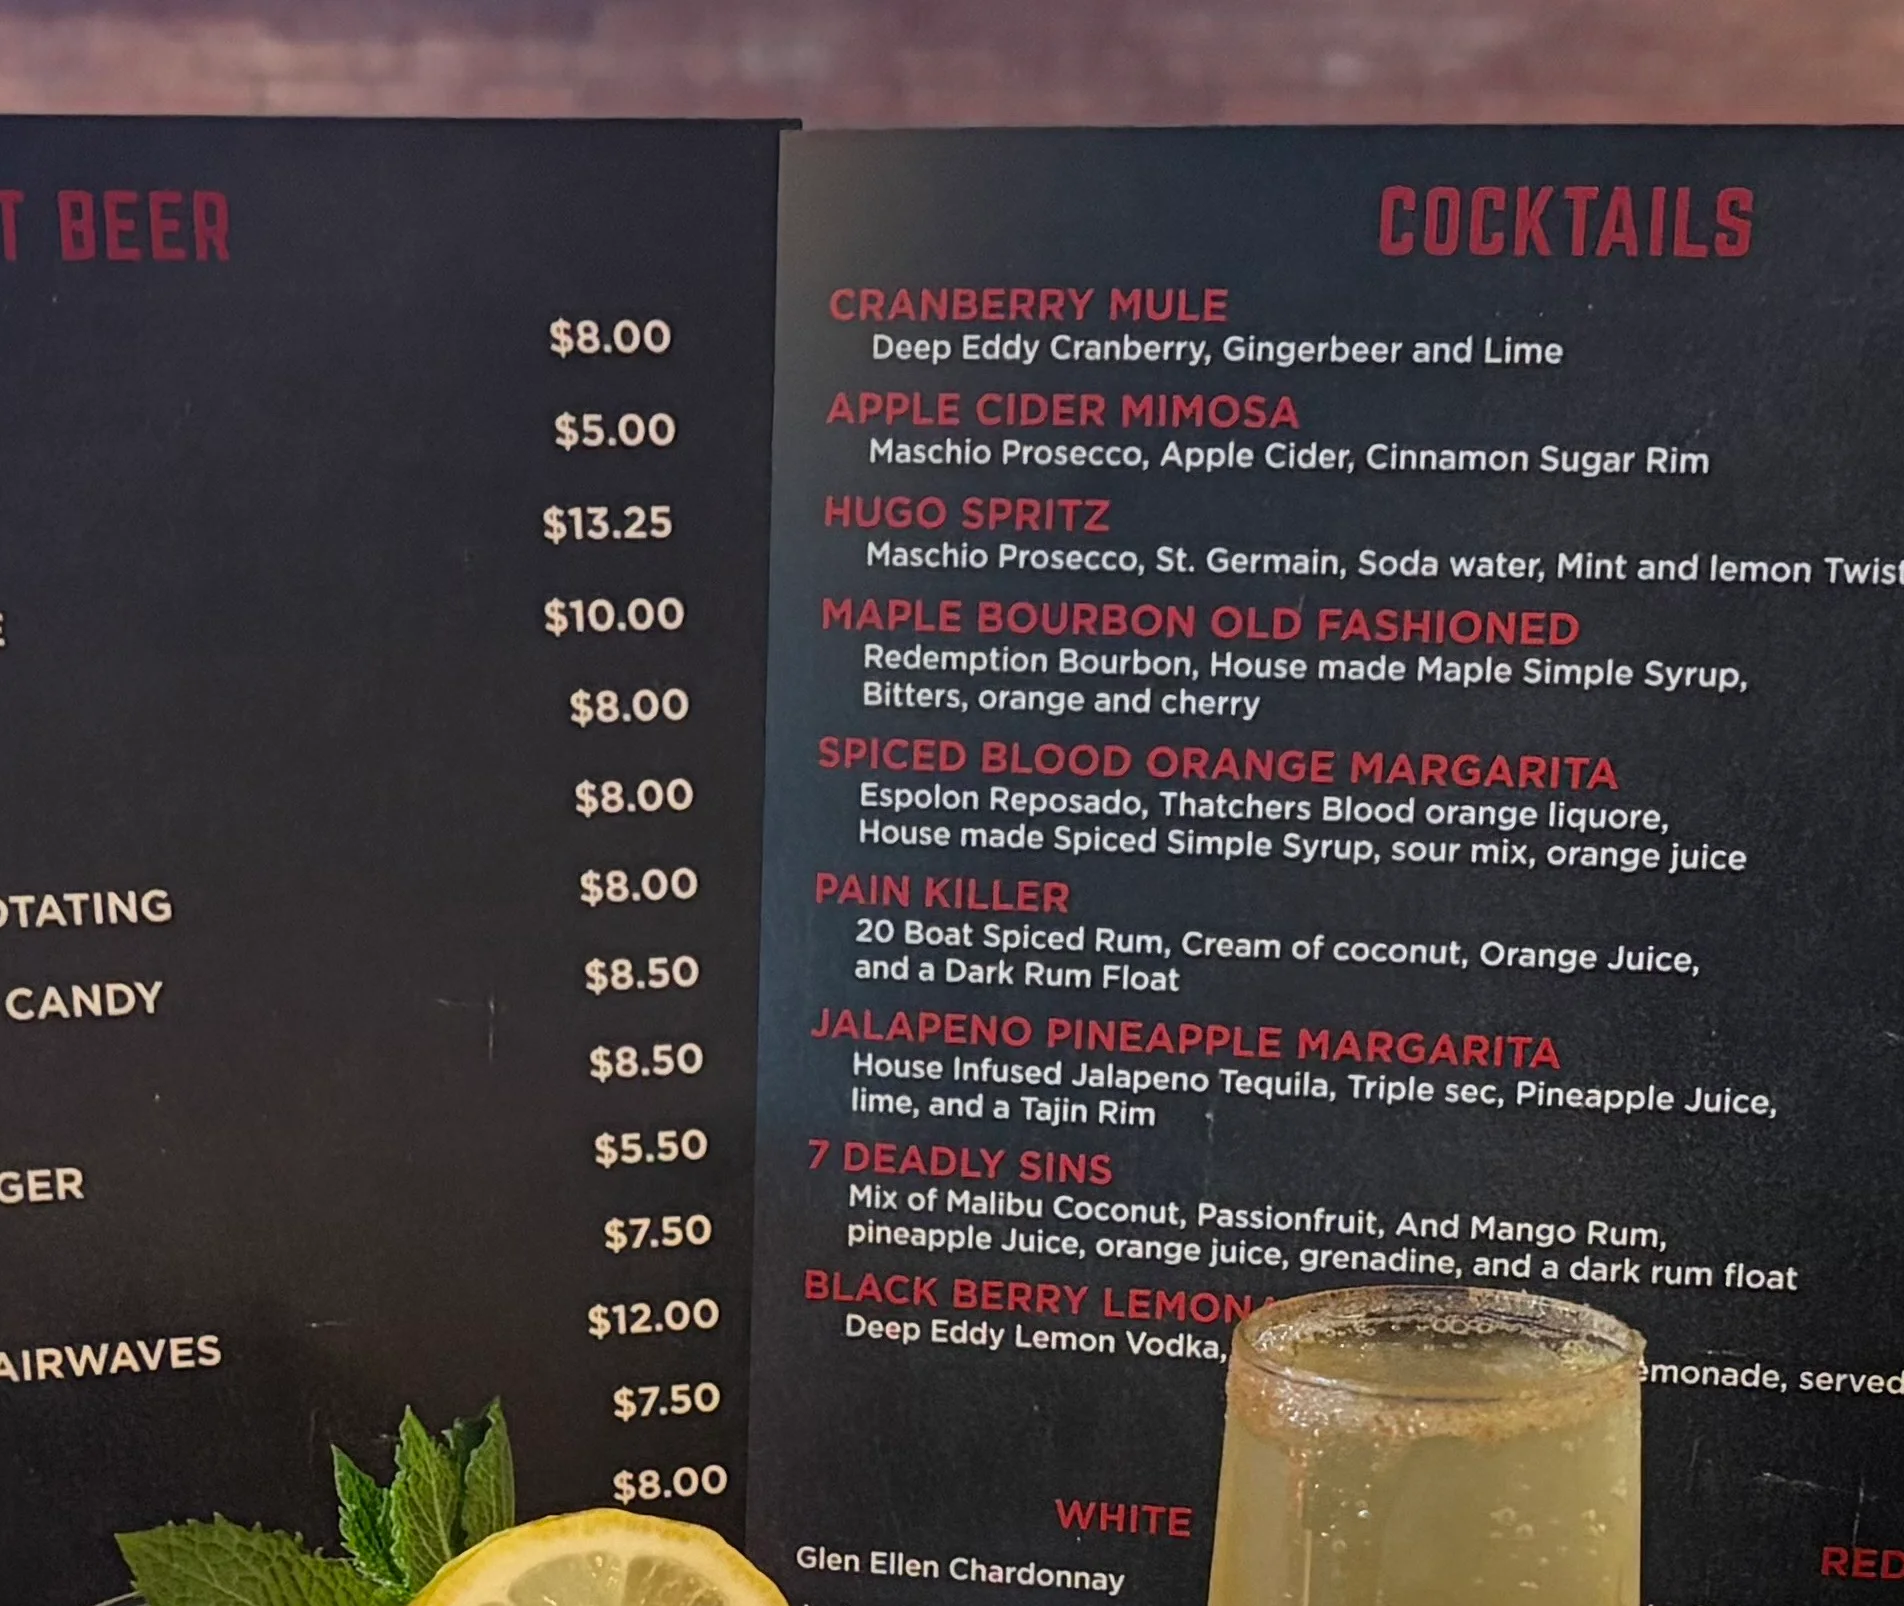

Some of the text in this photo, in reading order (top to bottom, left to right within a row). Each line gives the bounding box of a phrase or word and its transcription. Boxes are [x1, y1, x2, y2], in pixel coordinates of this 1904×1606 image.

[58, 189, 230, 262] BEER
[1380, 186, 1753, 259] COCKTAILS
[830, 287, 1227, 323] CRANBERRY MULE
[549, 317, 671, 359] $8.00
[872, 332, 1564, 368] Deep Eddy Cranberry, Gingerbeer and Lime
[828, 391, 1300, 429] APPLE CIDER MIMOSA
[554, 411, 676, 452] $5.00
[543, 505, 673, 545] $13.25
[825, 496, 1111, 533] HUGO SPRITZ
[544, 597, 685, 637] $10.00
[823, 599, 1581, 647] MAPLE BOURBON OLD FASHIONED
[569, 687, 689, 728] $8.00
[863, 680, 1261, 721] Bitters, orange and cherry
[819, 736, 1619, 792] SPICED BLOOD ORANGE MARGARITA
[575, 777, 694, 818] $8.00
[580, 866, 698, 908] $8.00
[816, 872, 1071, 914] PAIN KILLER
[584, 955, 699, 996] $8.50
[854, 955, 1181, 992] and a Dark Rum Float
[5, 980, 163, 1021] CANDY
[813, 1010, 1561, 1070] JALAPENO PINEAPPLE MARGARITA
[589, 1042, 704, 1084] $8.50
[851, 1086, 1156, 1127] lime, and a Tajin Rim
[594, 1128, 708, 1169] $5.50
[810, 1138, 1114, 1187] 7 DEADLY SINS
[604, 1214, 712, 1254] $7.50
[805, 1269, 1279, 1326] BLACK BERRY LEMON
[587, 1298, 720, 1340] $12.00
[613, 1382, 721, 1422] $7.50
[612, 1464, 728, 1506] $8.00
[1056, 1500, 1194, 1539] WHITE
[796, 1545, 1126, 1597] Glen Ellen Chardonnay
